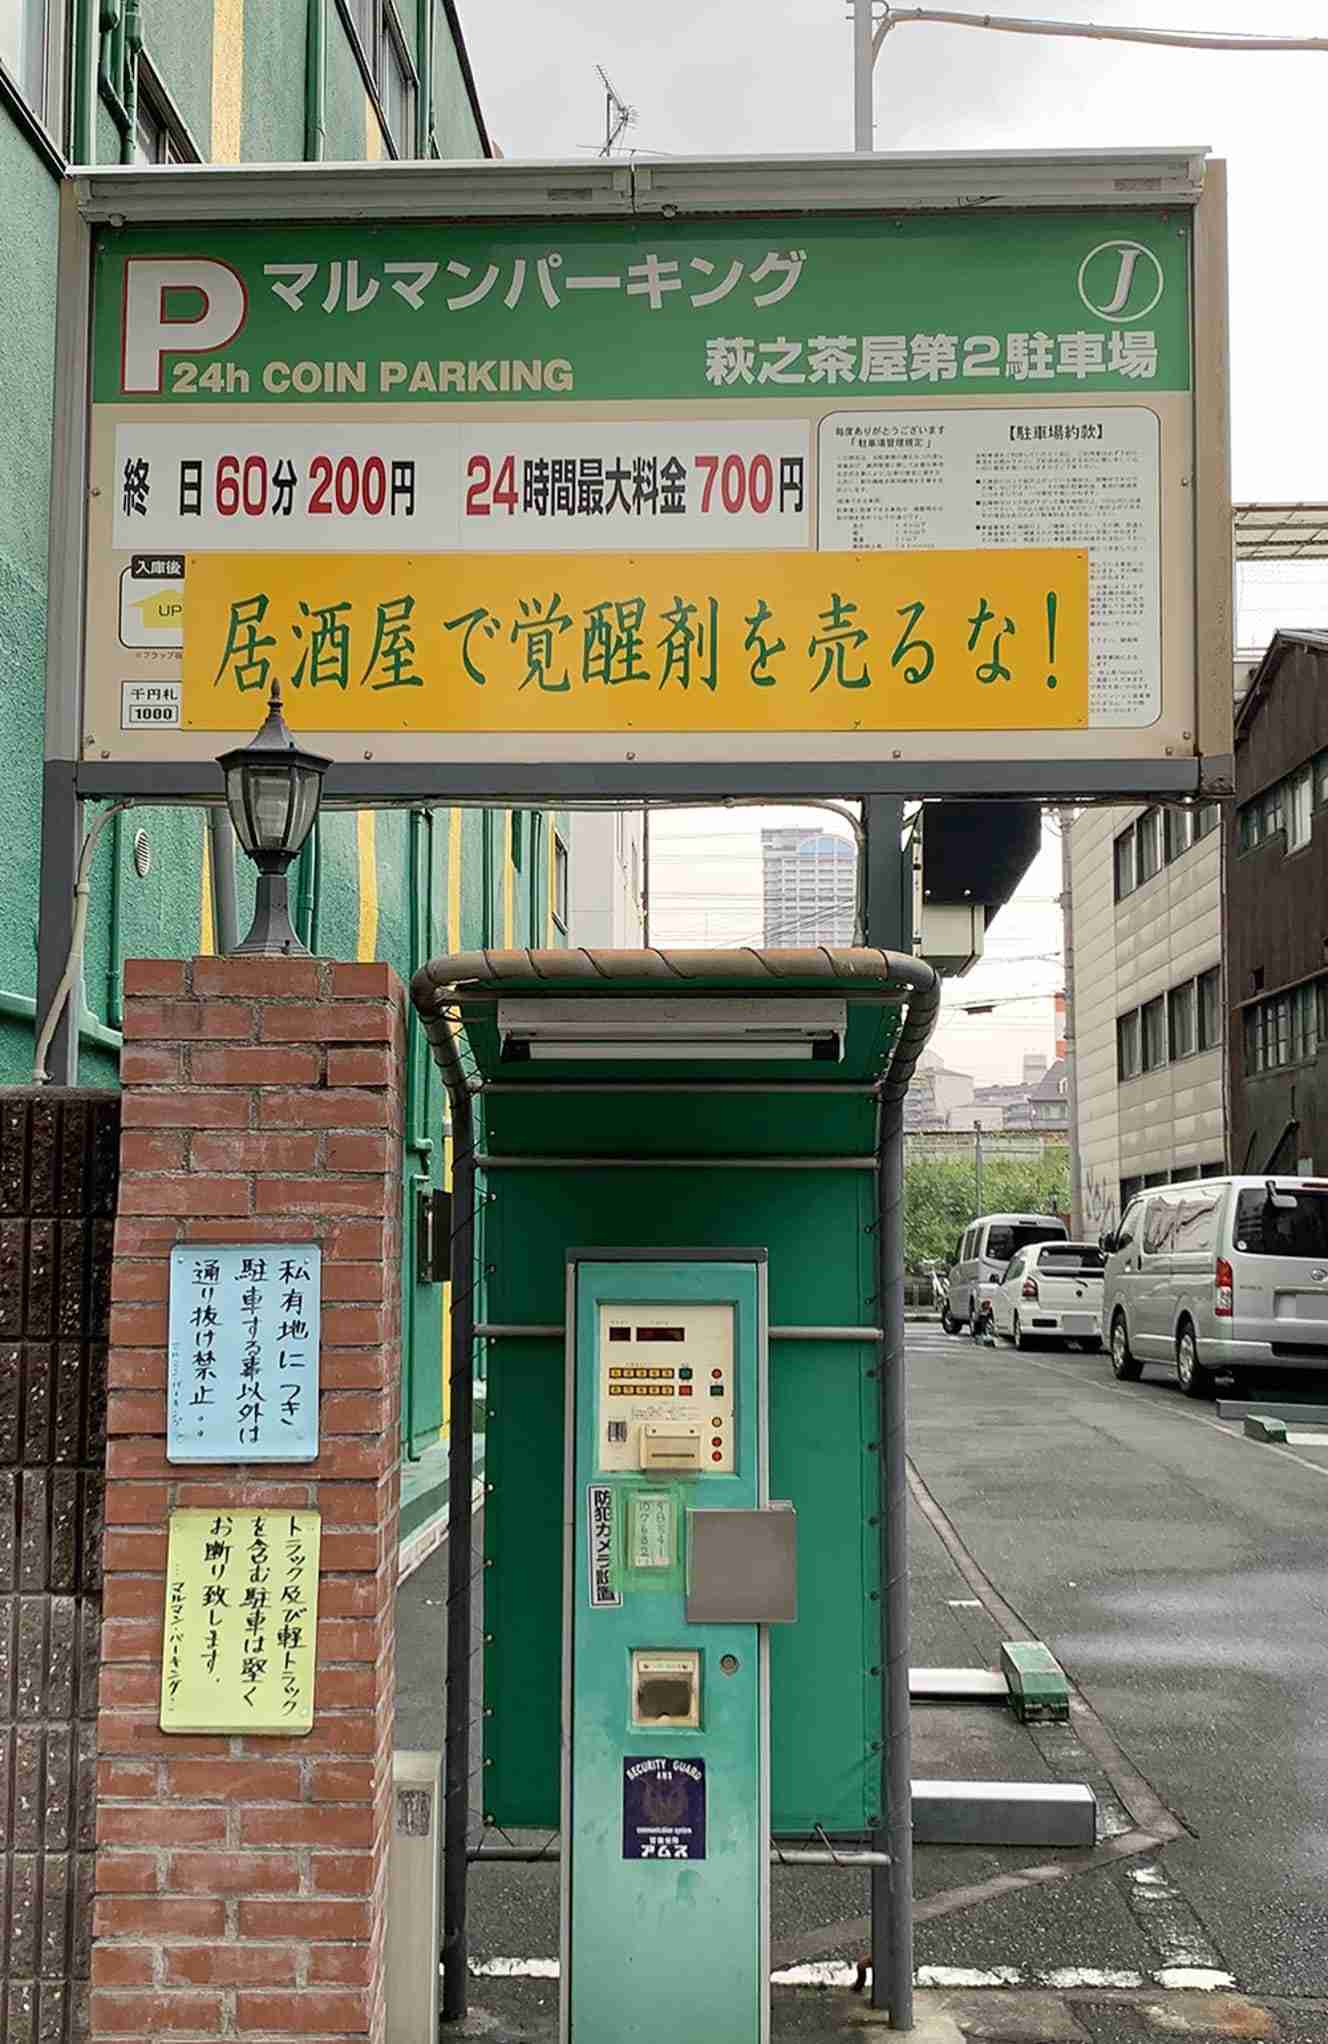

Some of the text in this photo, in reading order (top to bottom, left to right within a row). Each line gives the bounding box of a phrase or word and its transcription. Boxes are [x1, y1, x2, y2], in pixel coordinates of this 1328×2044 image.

[262, 248, 807, 314] マルマンパーキング
[124, 256, 247, 394] P
[171, 358, 575, 393] 24h COIN PARKING
[703, 329, 1160, 387] 萩之茶屋第2駐車場
[130, 687, 178, 701] 千円札
[134, 708, 173, 720] 1000
[275, 1514, 308, 1717] トラック及び軽トラック
[625, 1758, 703, 1781] SECURITY GUARD
